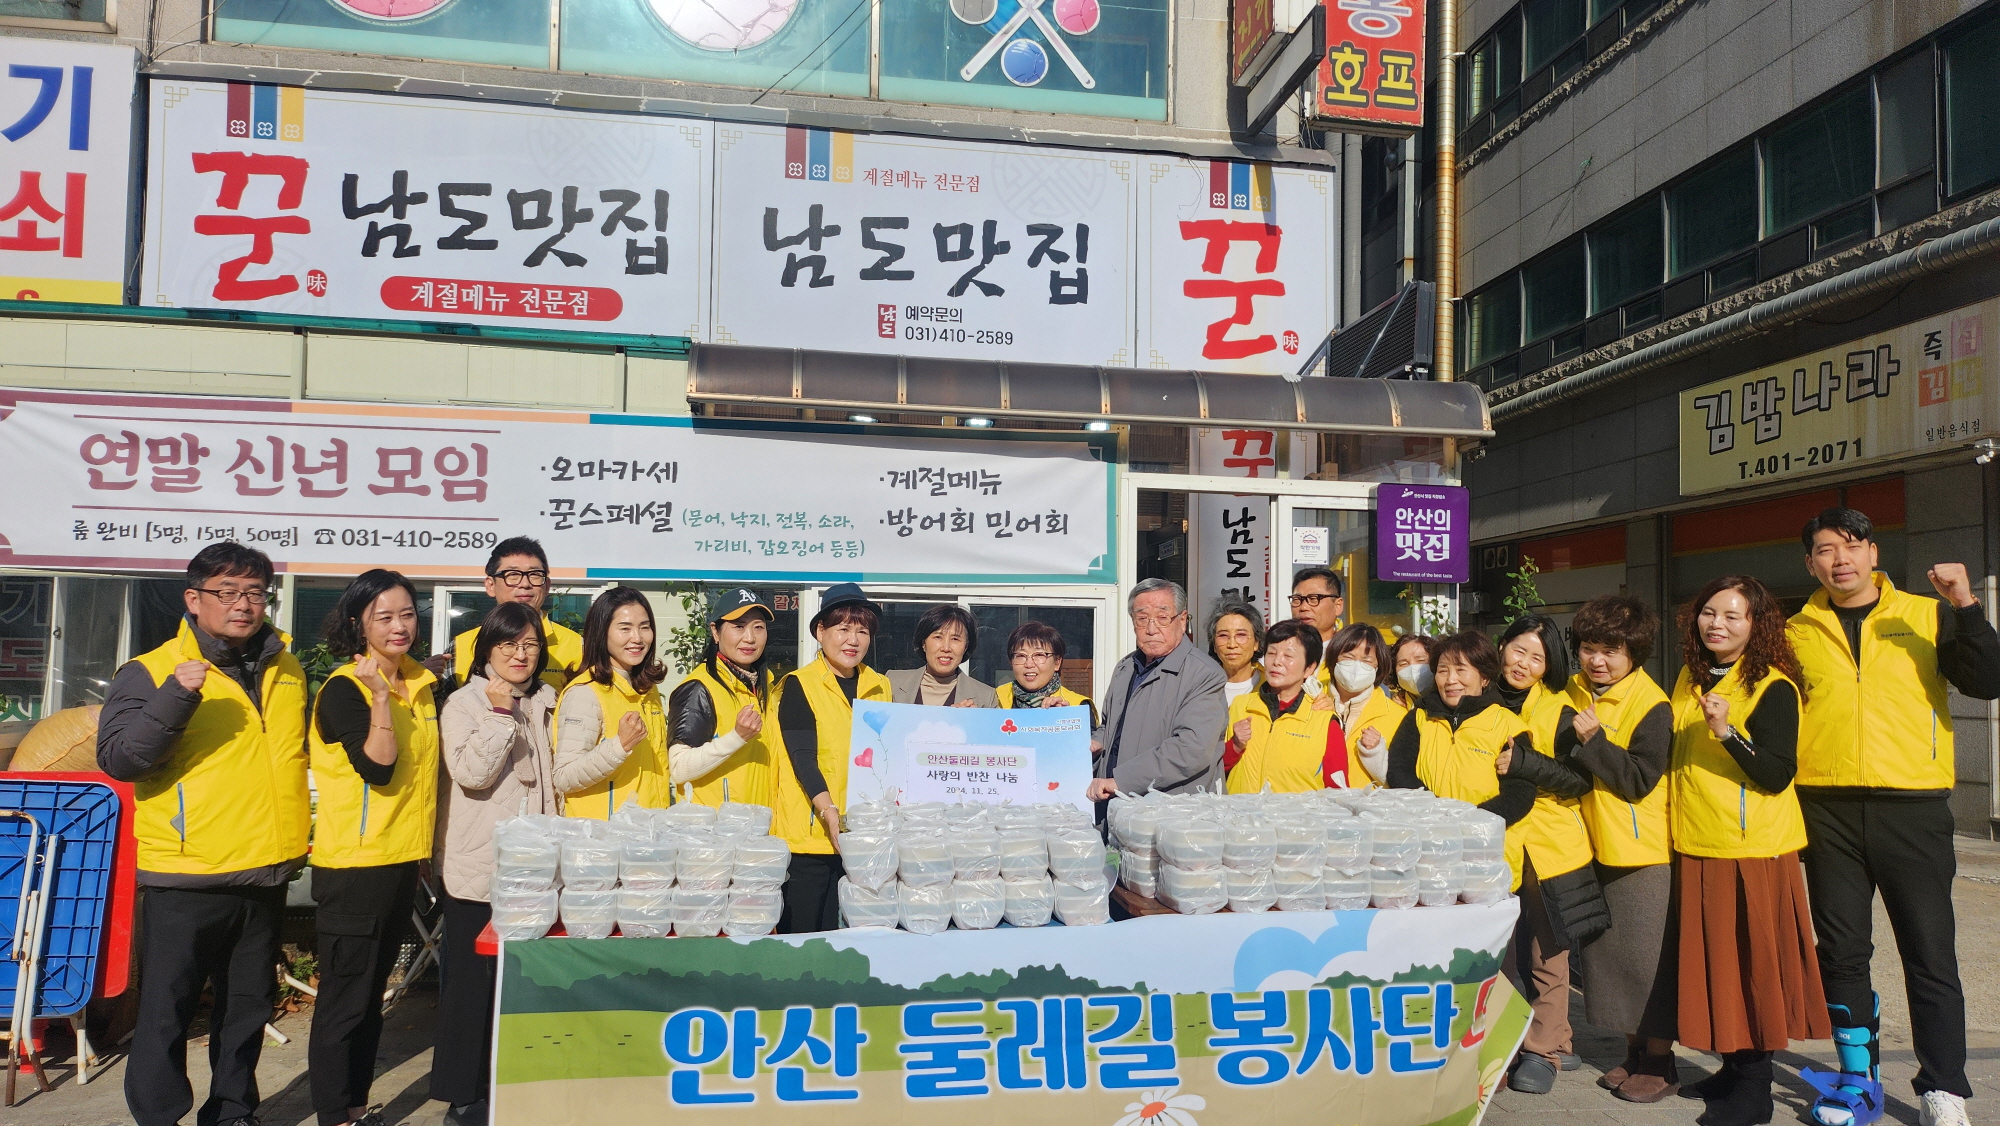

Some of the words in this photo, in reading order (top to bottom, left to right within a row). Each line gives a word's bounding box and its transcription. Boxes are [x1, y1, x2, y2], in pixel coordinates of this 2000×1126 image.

[1326, 43, 1417, 108] 호프
[0, 64, 94, 151] 기
[863, 168, 927, 189] 계절메뉴
[933, 172, 980, 193] 전문점
[0, 170, 87, 258] 쇠
[192, 151, 311, 300] 꾼
[342, 169, 669, 275] 남도맛집
[762, 203, 1089, 305] 남도맛집
[308, 272, 326, 293] 味
[1179, 220, 1286, 359] 꾼
[410, 280, 510, 312] 계절메뉴
[518, 286, 589, 316] 전문점
[880, 307, 896, 335] 남도
[905, 306, 962, 323] 예약문의
[905, 327, 1013, 345] 031)410-2589
[1283, 332, 1298, 353] 味
[1694, 344, 1900, 455] 김밥나라
[1925, 418, 1981, 442] 일반음식점
[80, 430, 210, 493] 연말
[225, 436, 349, 498] 신년
[368, 442, 489, 503] 모임
[551, 455, 678, 484] 오마카세
[1739, 438, 1862, 479] T.401-2071
[887, 466, 1002, 497] 계절메뉴
[549, 498, 673, 533] 꾼스페셜
[682, 508, 725, 527] (문어,
[731, 511, 770, 528] 낙지,
[776, 511, 812, 530] 전복,
[818, 514, 854, 530] 소라,
[887, 508, 976, 538] 방어회
[986, 509, 1068, 538] 민어회
[1395, 508, 1451, 531] 안산의
[73, 520, 90, 540] 룸
[96, 522, 138, 541] 완비
[146, 522, 188, 543] [5명,
[197, 524, 239, 544] 15명,
[247, 526, 298, 547] 50명]
[341, 529, 498, 549] 031-410-2589
[694, 540, 751, 554] 가리비,
[757, 540, 824, 557] 갑오징어
[830, 540, 865, 558] 등등)
[1394, 532, 1450, 562] 맛집
[927, 754, 980, 766] 안산둘레길
[986, 756, 1017, 767] 봉사단
[927, 770, 960, 782] 사랑의
[967, 771, 990, 783] 반찬
[996, 772, 1018, 784] 나눔
[988, 788, 1000, 796] 25.
[666, 1006, 868, 1103] 안산
[899, 994, 1180, 1098] 둘레길
[1206, 981, 1456, 1087] 봉사단
